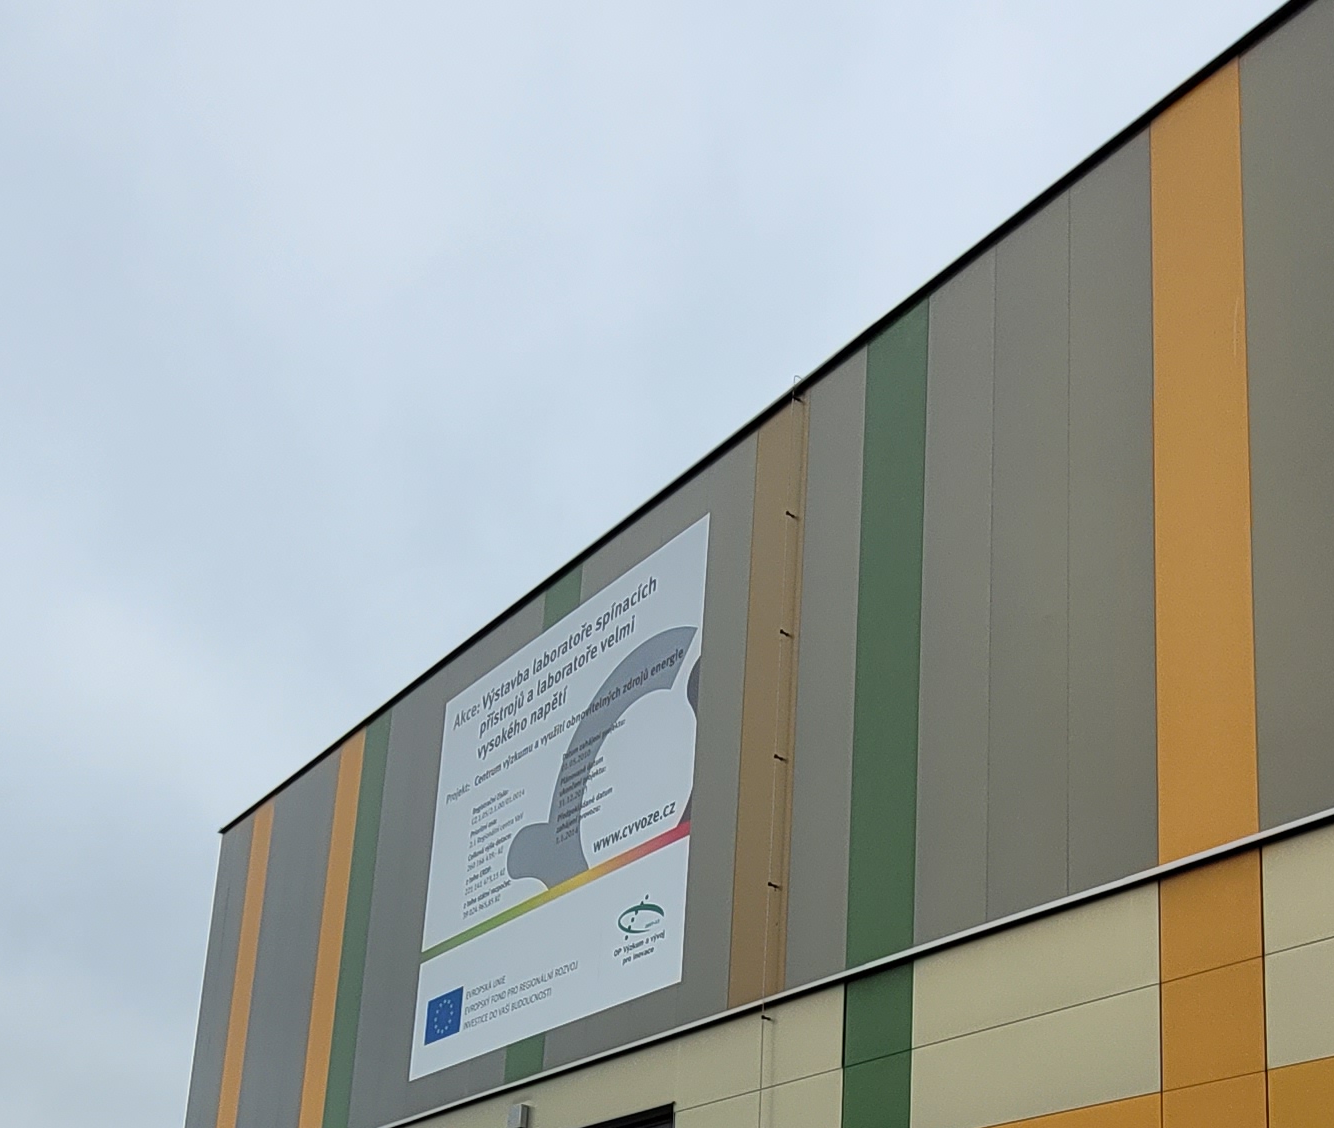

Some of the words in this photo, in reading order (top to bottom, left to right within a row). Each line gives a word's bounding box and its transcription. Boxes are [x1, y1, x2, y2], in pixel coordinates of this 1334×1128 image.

[453, 703, 481, 730] Akce:
[482, 668, 529, 710] Výstavba
[532, 622, 592, 675] laboratoře
[595, 576, 656, 631] spínacích
[479, 691, 524, 739] přístrojů
[526, 688, 534, 703] a
[536, 644, 597, 696] laboratoře
[600, 614, 635, 652] velmi
[474, 763, 502, 786] Centrum
[502, 743, 533, 769] výzkumu
[533, 739, 539, 749] a
[540, 720, 565, 746] využití
[565, 687, 621, 729] obnovitelných
[622, 667, 649, 694] zdrojů
[650, 648, 684, 676] energie
[477, 717, 527, 760] vysokého
[529, 685, 567, 725] napětí
[593, 801, 675, 852] www.cvvoze.cz
